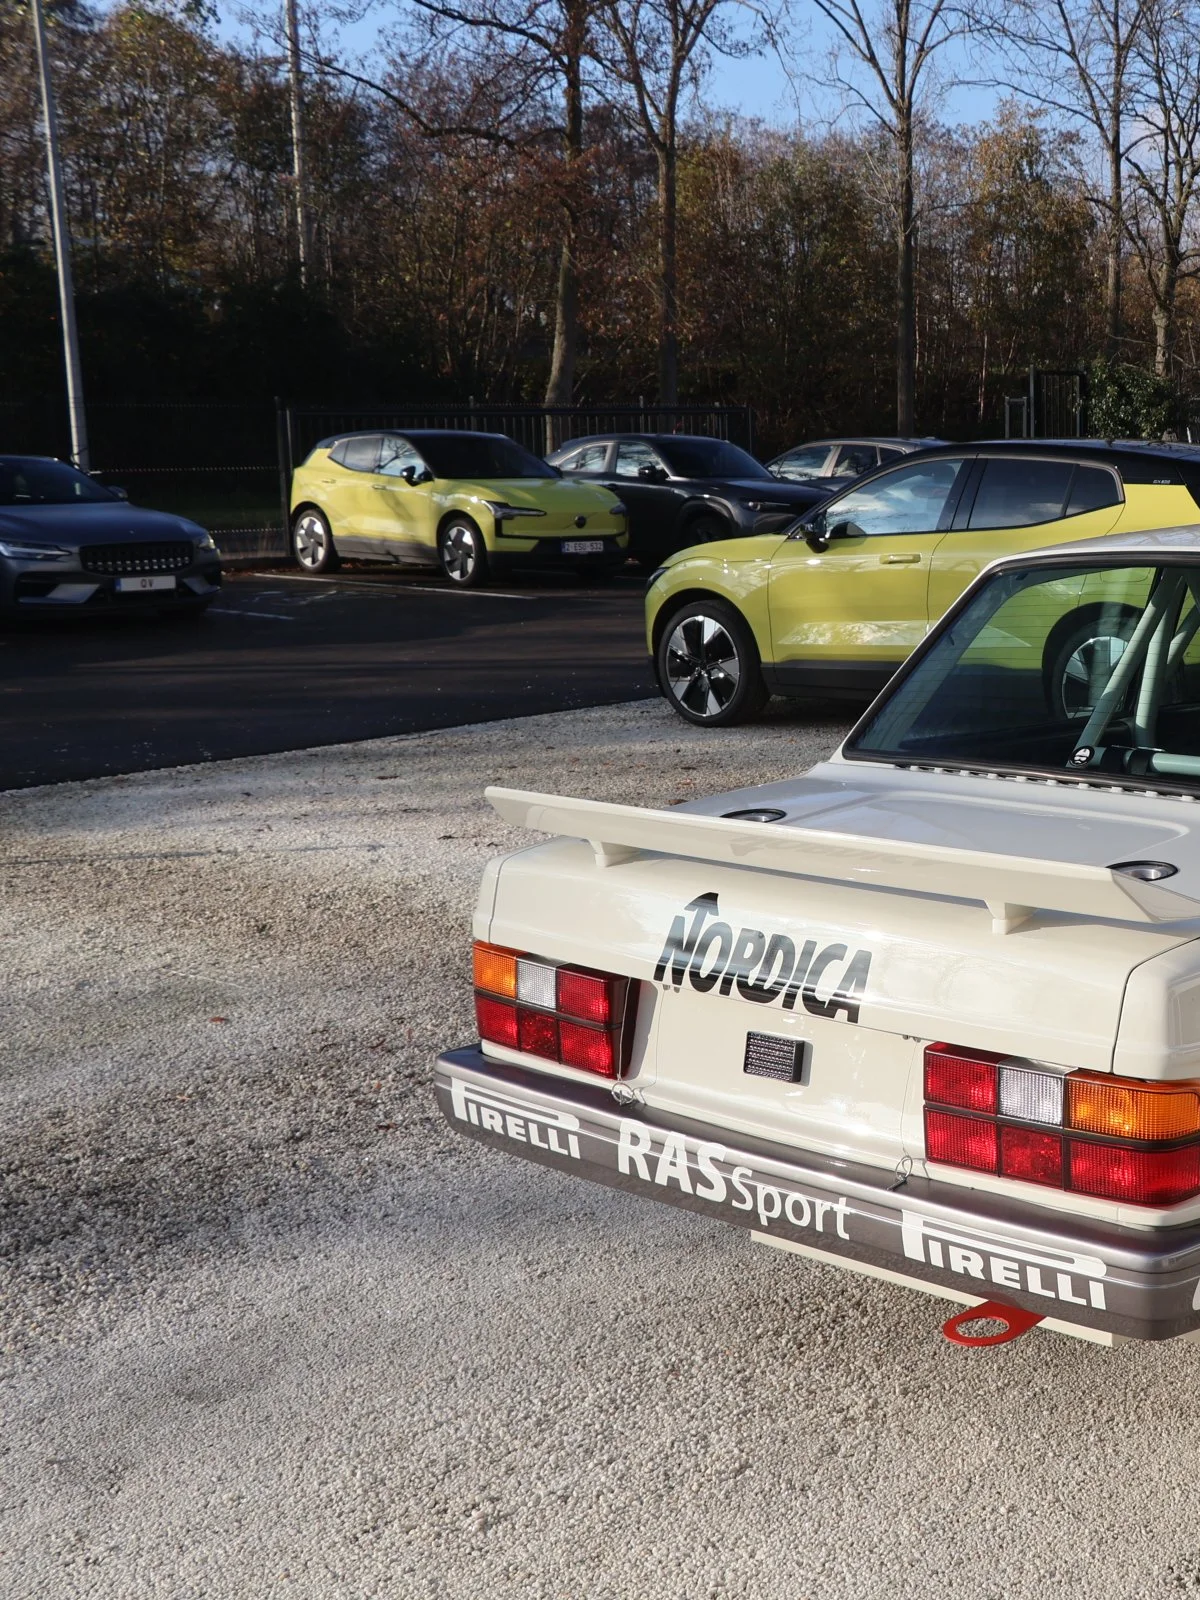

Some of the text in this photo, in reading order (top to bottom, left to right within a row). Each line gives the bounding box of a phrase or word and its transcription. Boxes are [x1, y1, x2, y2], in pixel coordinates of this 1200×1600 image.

[653, 892, 872, 1024] NORDICA
[451, 1076, 581, 1159] PIRELLI
[617, 1119, 857, 1240] RAS Sport
[901, 1210, 1107, 1309] PIRELLI
